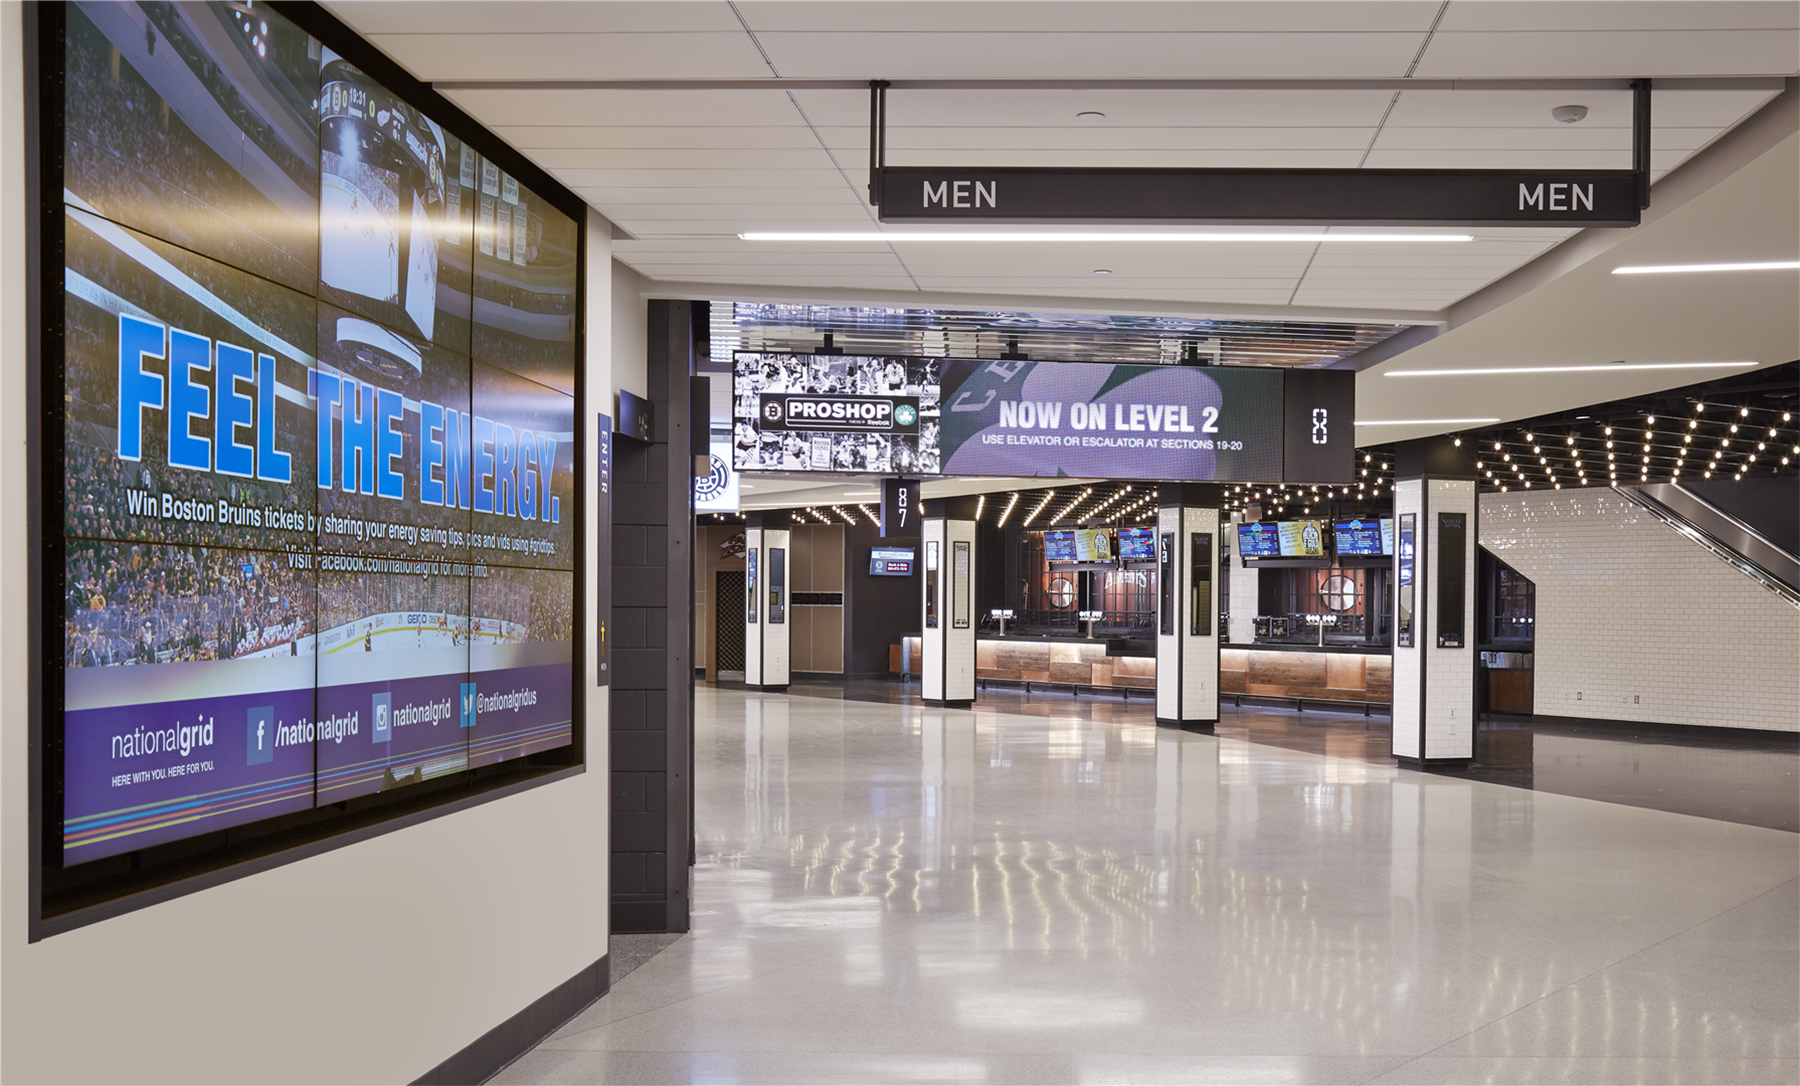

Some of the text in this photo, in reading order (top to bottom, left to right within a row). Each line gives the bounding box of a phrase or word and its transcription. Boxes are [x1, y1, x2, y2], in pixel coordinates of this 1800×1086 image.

[922, 181, 997, 208] MEN
[1519, 183, 1594, 211] MEN
[118, 312, 291, 484] FEEL
[307, 367, 404, 500] THE
[420, 400, 560, 524] ENERGY.
[789, 402, 891, 419] PROSHOP
[999, 401, 1218, 433] NOW ON LEVEL 2
[1312, 408, 1327, 444] 8
[982, 434, 1243, 450] USE ELEVATOR OR ESCALATOR AT SECTIONS 19-20
[126, 489, 158, 516] Win
[162, 493, 214, 522] Boston
[218, 500, 262, 527] Bruins
[264, 506, 304, 531] tickets
[307, 511, 322, 537] by
[325, 513, 363, 541] sharing
[365, 521, 387, 541] your
[389, 524, 418, 545] energy
[420, 525, 447, 548] saving
[466, 530, 482, 549] pics
[483, 533, 496, 548] and
[497, 533, 510, 550] vids
[512, 536, 529, 555] using
[286, 544, 312, 569] Visit
[440, 555, 451, 575] for
[453, 560, 473, 576] more
[393, 698, 451, 727] nationalgrid
[476, 688, 538, 714] @nationalgridus
[112, 714, 214, 757] nationalgrid
[275, 711, 359, 748] /nationalgrid
[112, 761, 214, 787] HERE WITH YOU. HERE FOR YOU.
